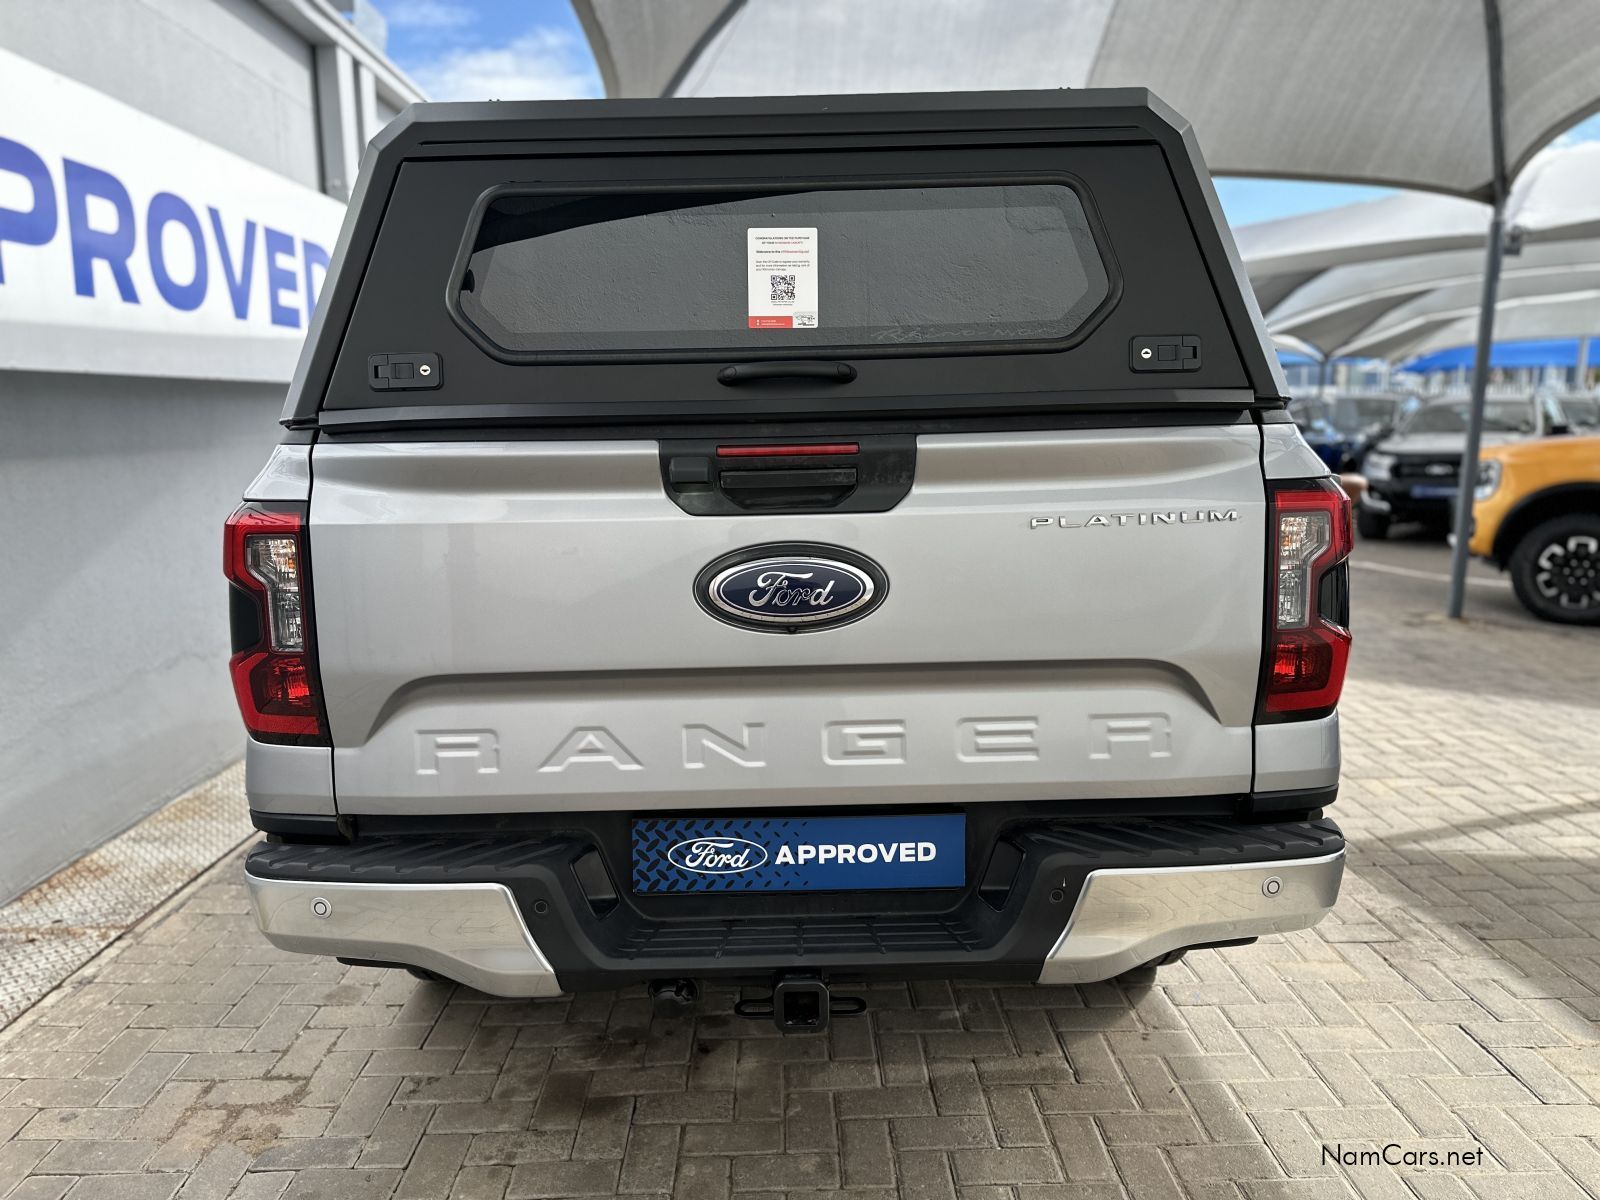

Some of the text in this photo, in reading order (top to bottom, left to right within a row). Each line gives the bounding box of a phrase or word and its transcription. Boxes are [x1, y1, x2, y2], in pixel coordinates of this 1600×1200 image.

[1030, 509, 1238, 529] PLATINUM
[748, 571, 835, 607] Ford
[413, 711, 1172, 775] RANGER
[684, 841, 937, 868] Ford APPROVED
